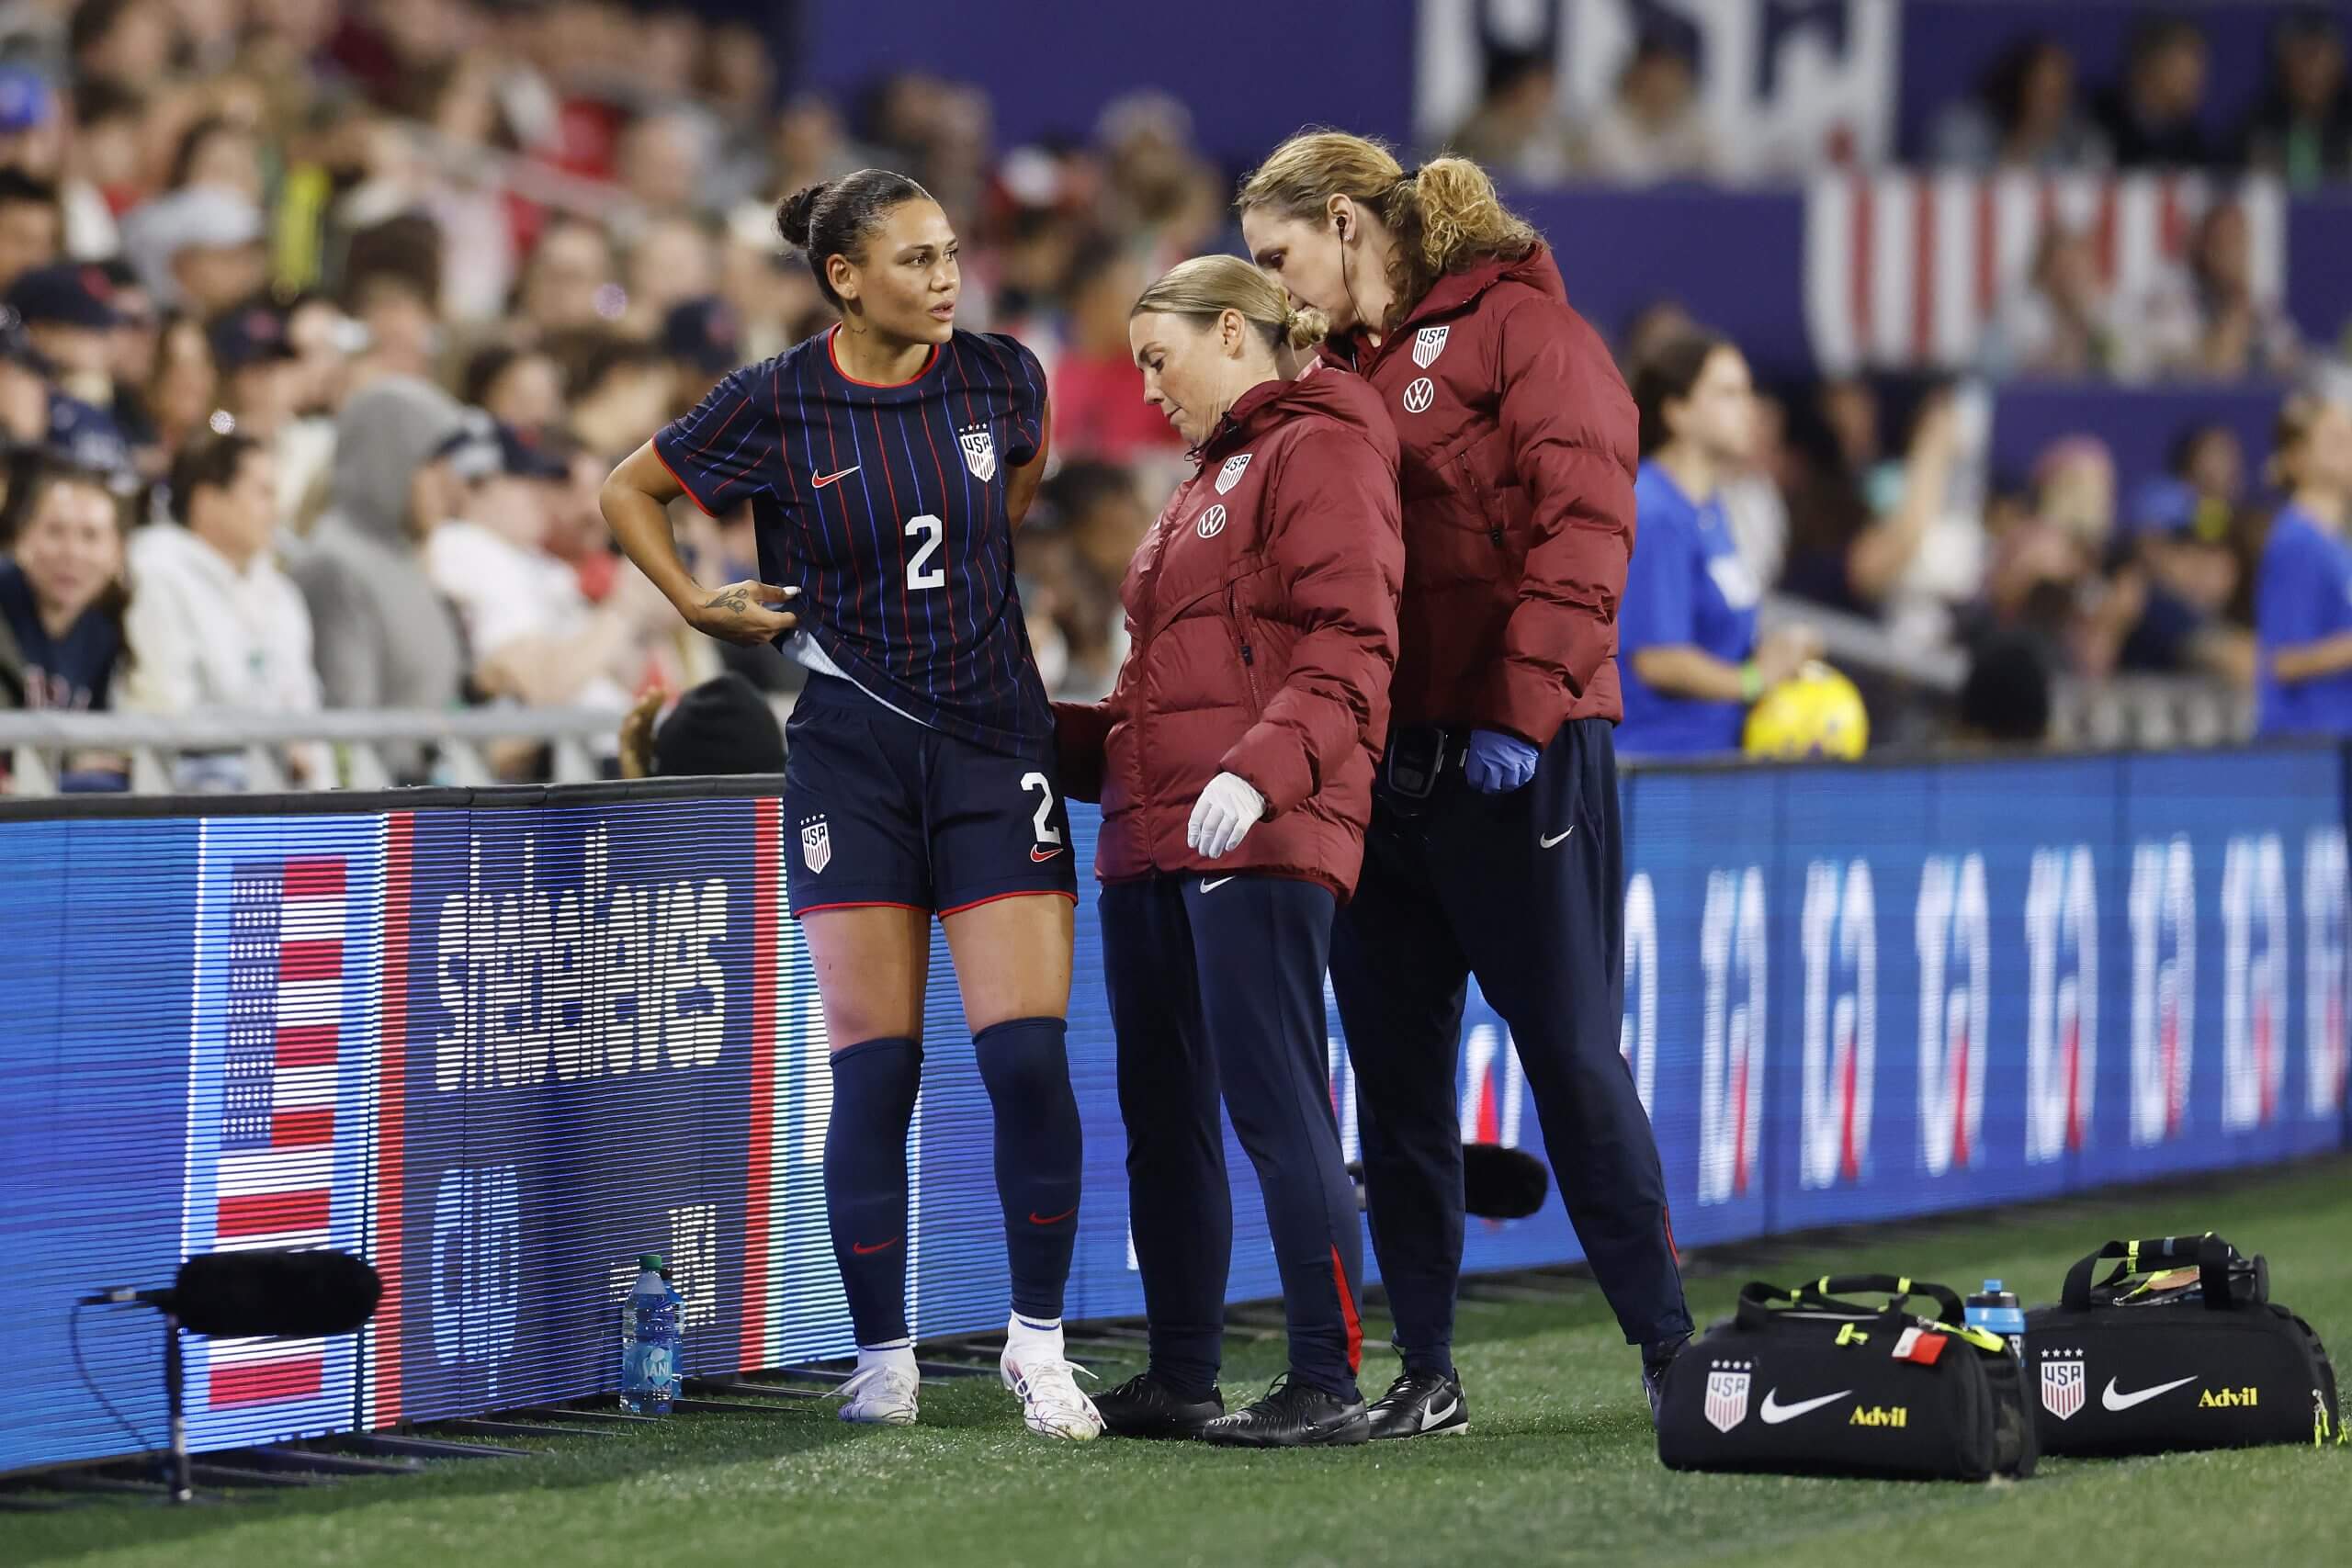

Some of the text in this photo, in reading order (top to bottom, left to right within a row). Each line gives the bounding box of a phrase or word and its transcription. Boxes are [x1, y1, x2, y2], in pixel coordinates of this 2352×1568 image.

[1419, 329, 1446, 344] USA
[964, 435, 989, 454] USA
[1225, 457, 1249, 471] USA
[905, 514, 944, 590] 2
[1020, 772, 1061, 844] 2
[803, 826, 826, 846] USA
[435, 820, 728, 1091] shebelieves
[432, 1165, 520, 1397] cup
[2044, 1365, 2082, 1386] USA
[1711, 1377, 1746, 1397] USA
[2198, 1387, 2257, 1407] Advil
[1849, 1405, 1906, 1427] Advil
